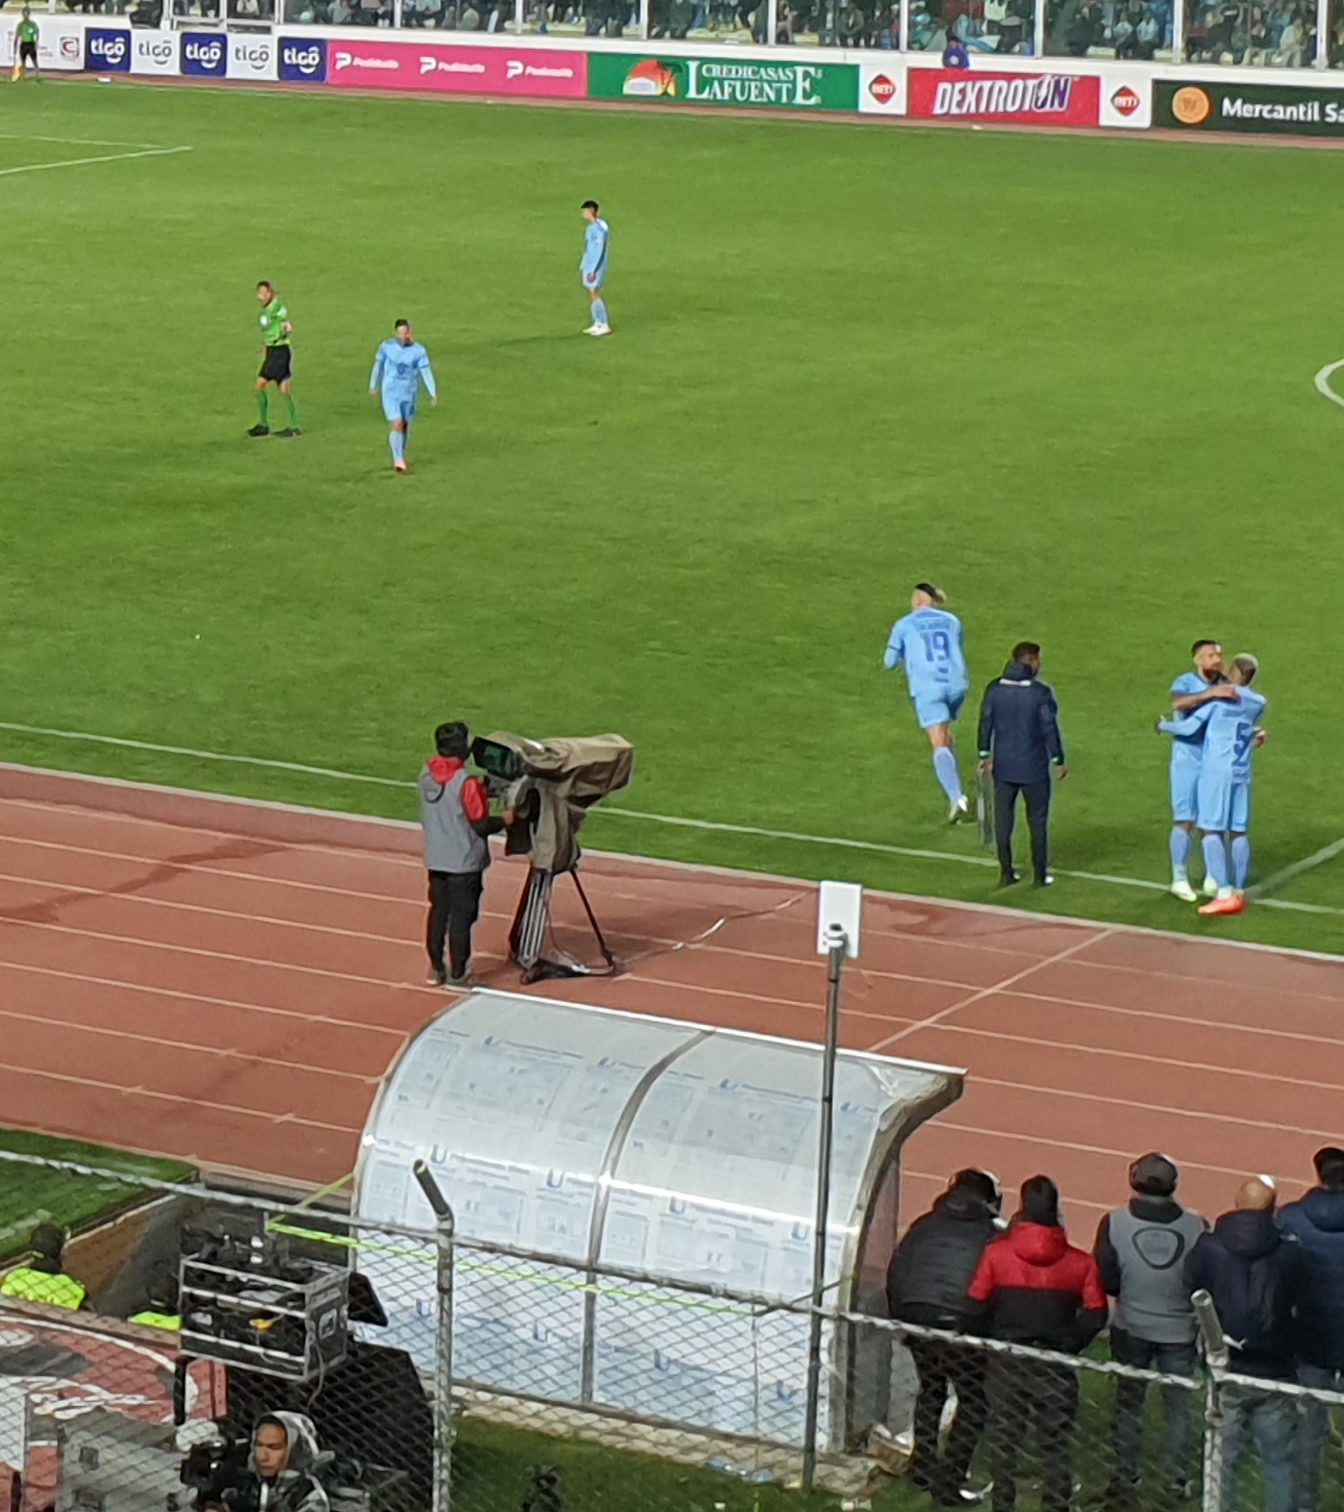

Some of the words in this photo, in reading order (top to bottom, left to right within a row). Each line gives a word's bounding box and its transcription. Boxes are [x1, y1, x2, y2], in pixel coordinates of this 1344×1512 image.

[685, 60, 819, 105] LAFUENTE
[702, 63, 794, 81] CREDICASAS
[1222, 96, 1320, 122] Mercantil
[920, 631, 949, 663] 19
[1234, 722, 1252, 757] 5
